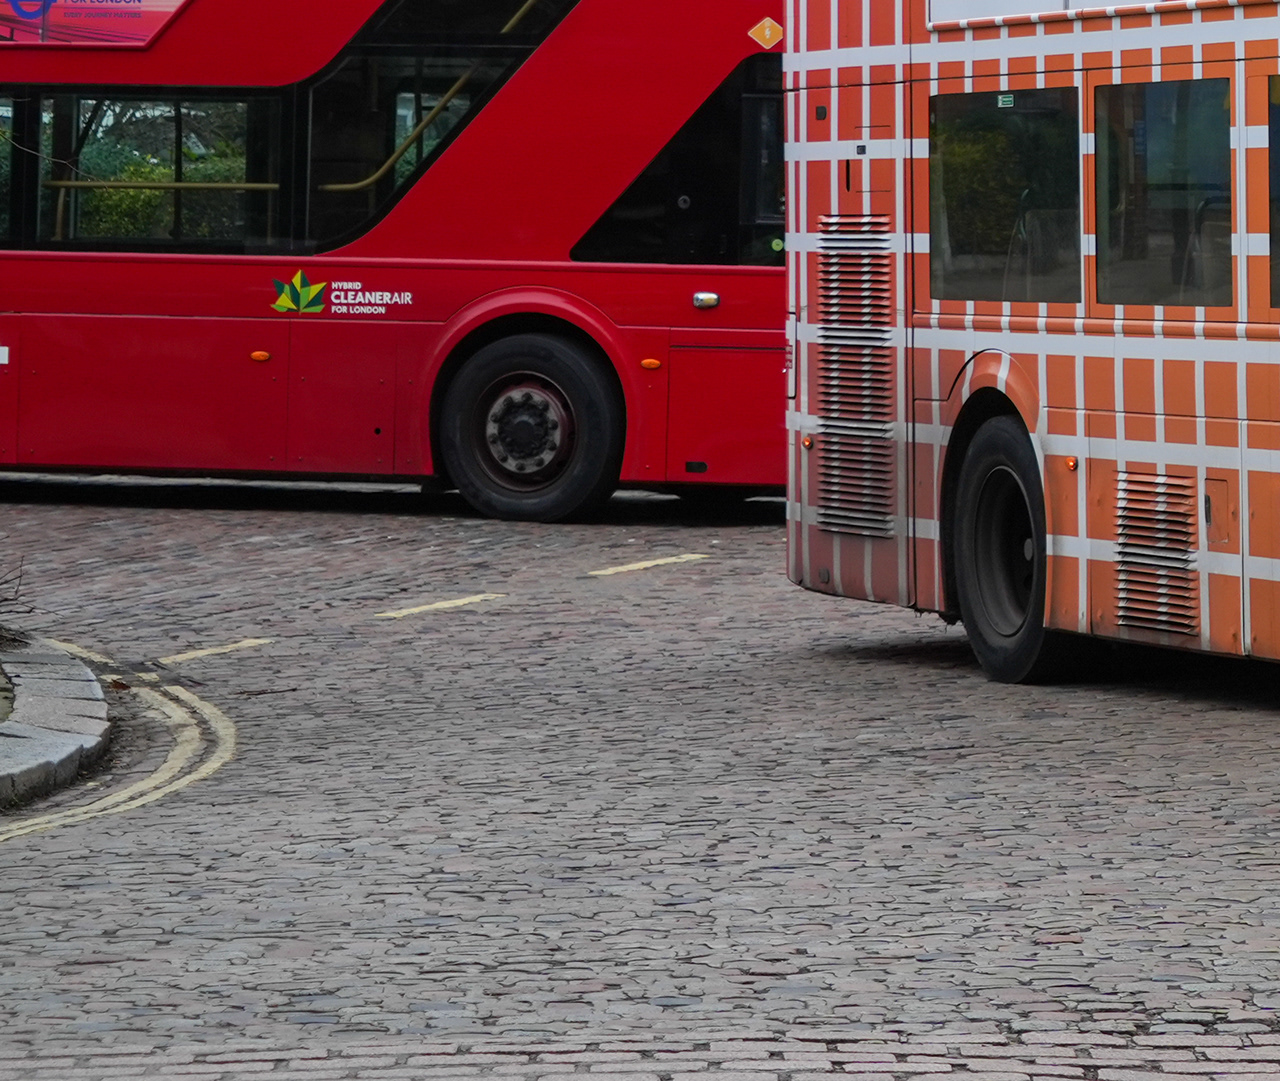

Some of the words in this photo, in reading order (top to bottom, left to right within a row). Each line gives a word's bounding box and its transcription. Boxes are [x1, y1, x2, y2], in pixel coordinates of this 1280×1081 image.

[331, 281, 362, 290] HYBRID
[331, 305, 348, 314] FOR
[349, 305, 386, 314] LONDON
